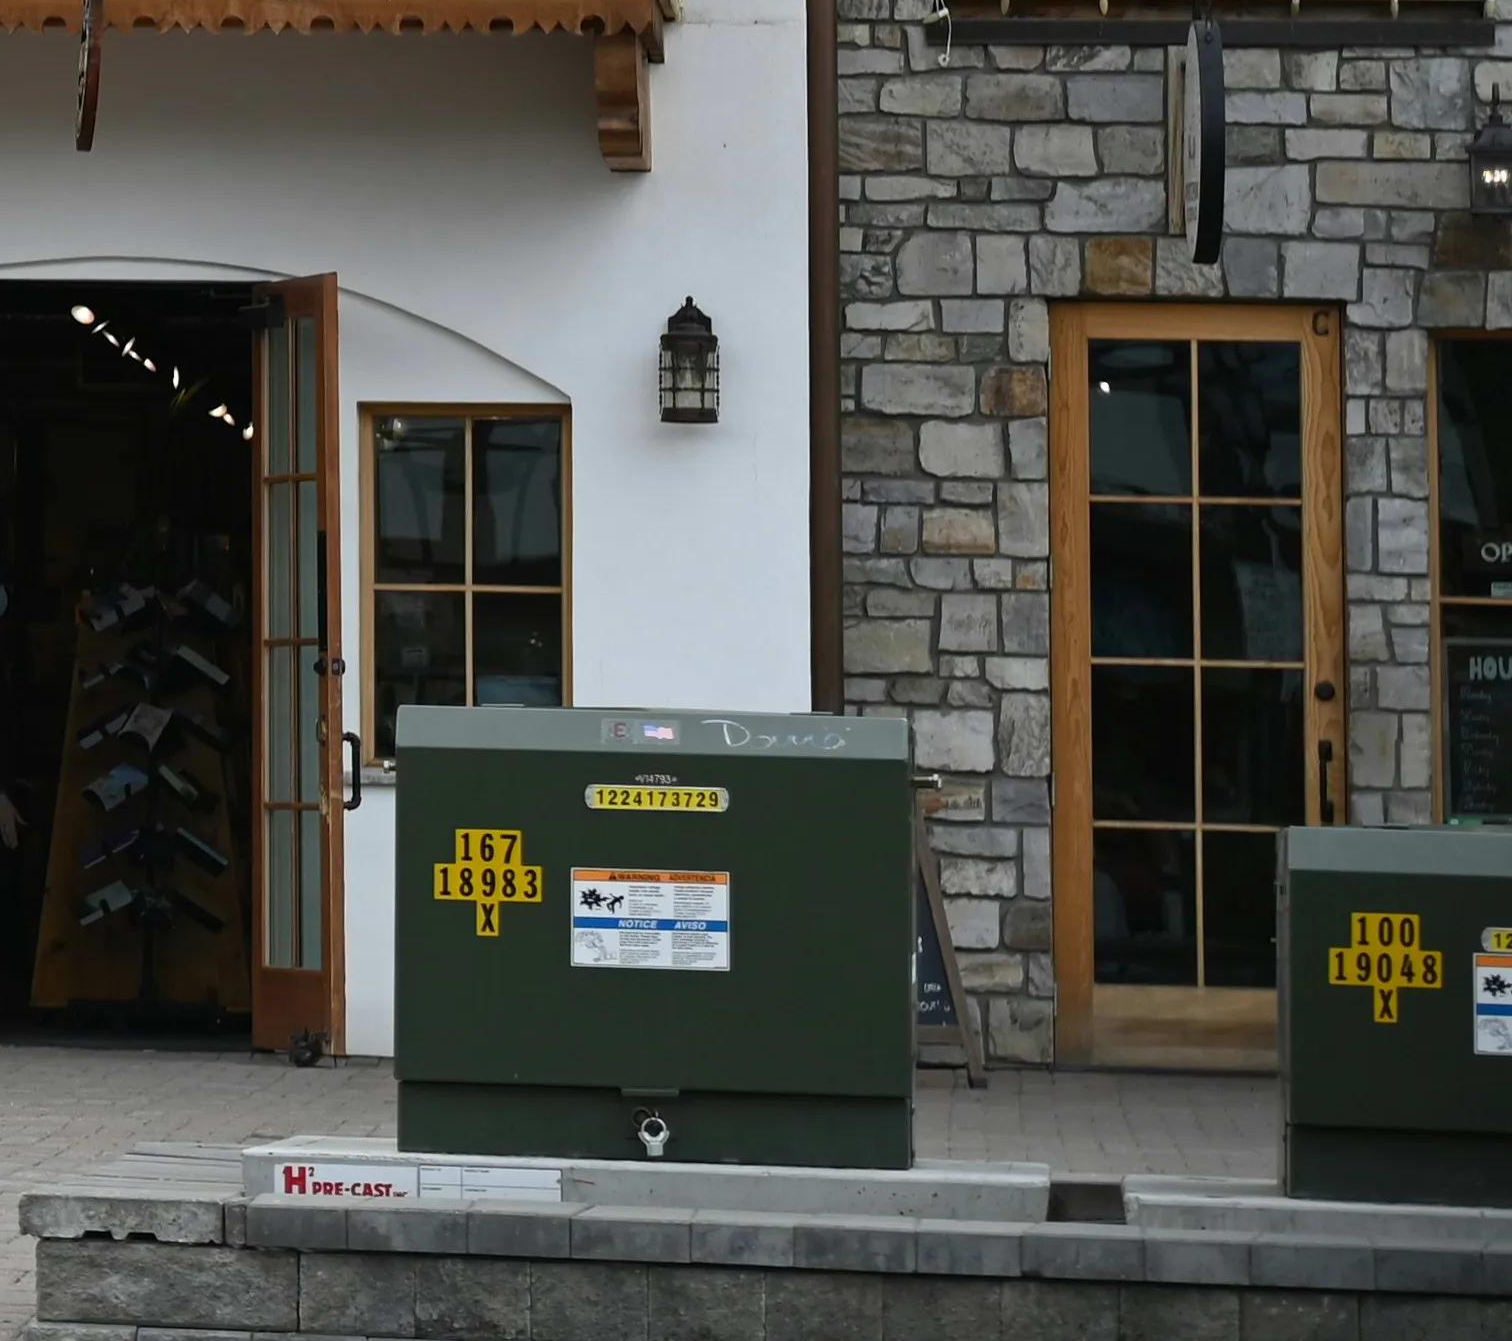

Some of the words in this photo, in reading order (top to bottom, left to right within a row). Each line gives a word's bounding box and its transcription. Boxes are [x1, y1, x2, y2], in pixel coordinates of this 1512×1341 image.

[596, 789, 719, 808] 1224173729
[460, 833, 518, 864] 167
[439, 866, 538, 899] 18983
[480, 903, 495, 933] X
[618, 920, 658, 929] NOTICE
[674, 921, 707, 930] AVISO
[1357, 917, 1414, 947] 100
[1335, 951, 1438, 985] 19048
[1379, 989, 1394, 1019] X
[312, 1181, 393, 1197] PRE-CAST
